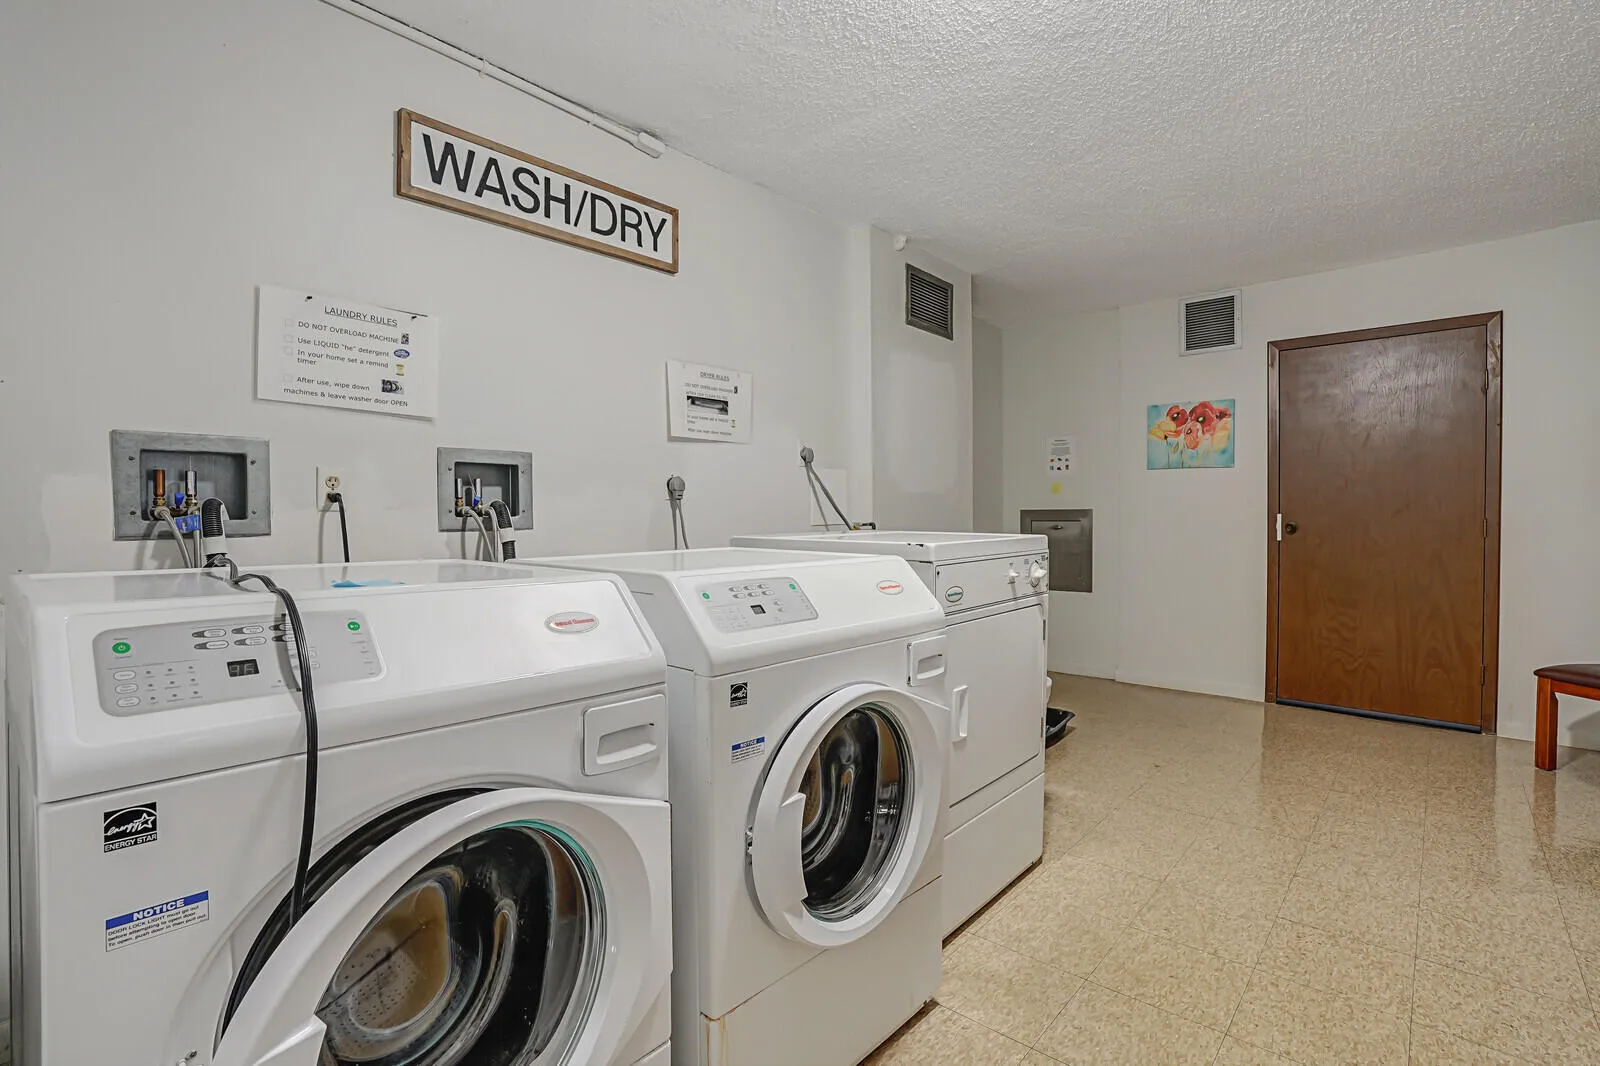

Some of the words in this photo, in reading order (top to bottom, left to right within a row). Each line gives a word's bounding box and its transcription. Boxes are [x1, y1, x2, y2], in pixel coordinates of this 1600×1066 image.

[423, 133, 667, 252] WASH/DRY
[324, 305, 367, 321] LAUNDRY
[370, 314, 398, 327] RULES
[329, 326, 367, 338] OVERLOAD
[369, 334, 399, 344] MACHINE
[297, 337, 312, 345] Use
[313, 339, 340, 350] LIQUID
[358, 346, 389, 358] detergent
[297, 357, 317, 366] timer
[307, 351, 324, 360] your
[325, 353, 346, 361] home
[366, 359, 389, 368] remind
[297, 376, 314, 384] After
[334, 382, 350, 390] wipe
[351, 383, 370, 391] down
[283, 387, 318, 397] machines
[328, 392, 346, 400] leave
[348, 395, 372, 403] washer
[374, 397, 389, 405] door
[390, 399, 408, 407] OPEN
[104, 839, 136, 852] ENERGY
[137, 833, 157, 845] STAR
[133, 898, 185, 921] NOTICE
[108, 926, 127, 936] DOOR
[128, 921, 145, 931] LOCK
[147, 915, 165, 925] LIGHT
[108, 933, 128, 942] before
[129, 922, 160, 936] attempting
